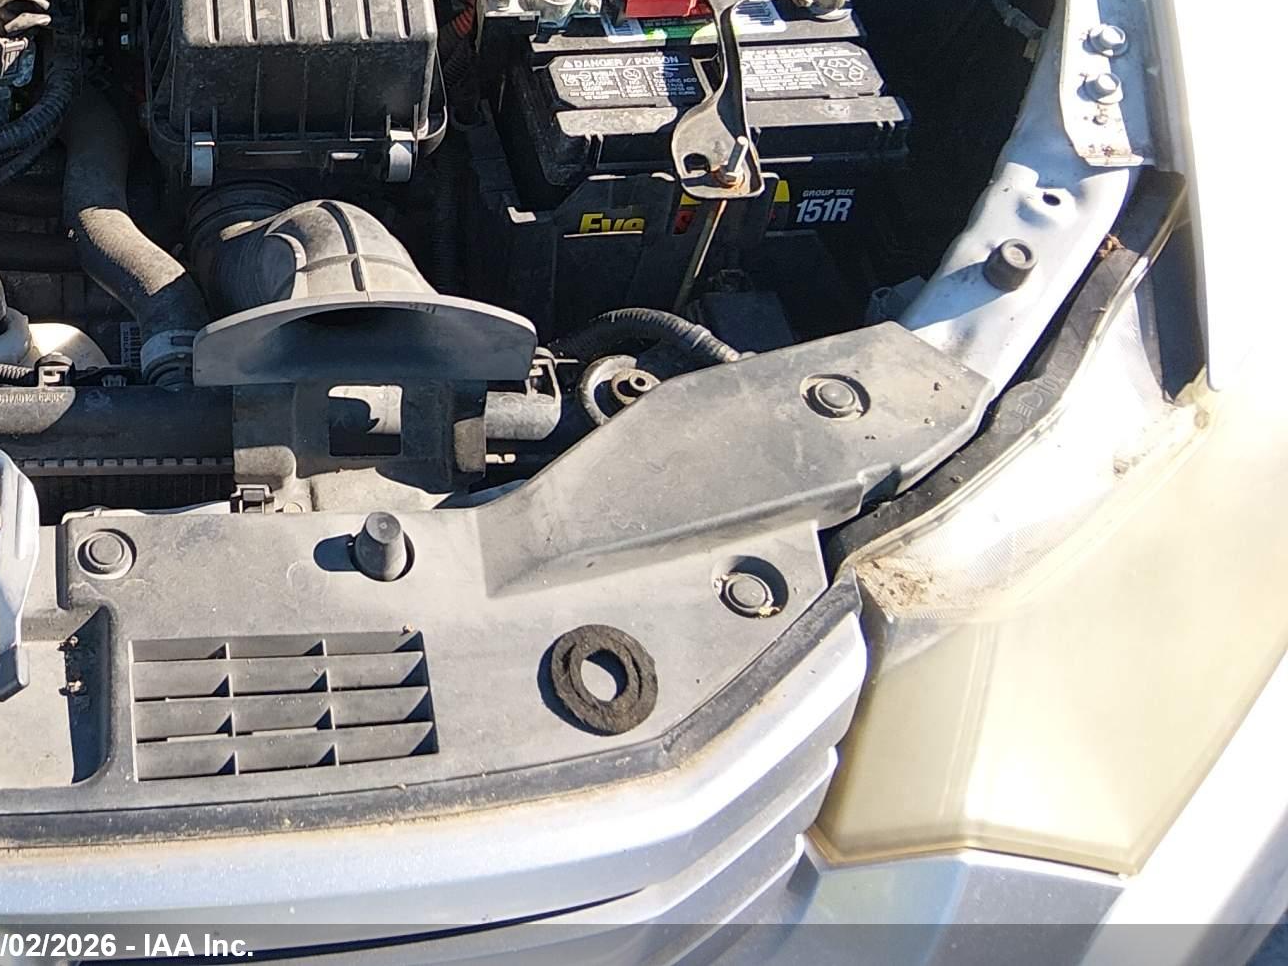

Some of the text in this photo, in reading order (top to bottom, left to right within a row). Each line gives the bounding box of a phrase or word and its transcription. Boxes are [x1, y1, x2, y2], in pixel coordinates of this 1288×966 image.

[573, 57, 623, 68] DANGER
[635, 55, 679, 66] POISON
[802, 188, 856, 197] GROUP SIZE
[796, 198, 853, 223] 151R
